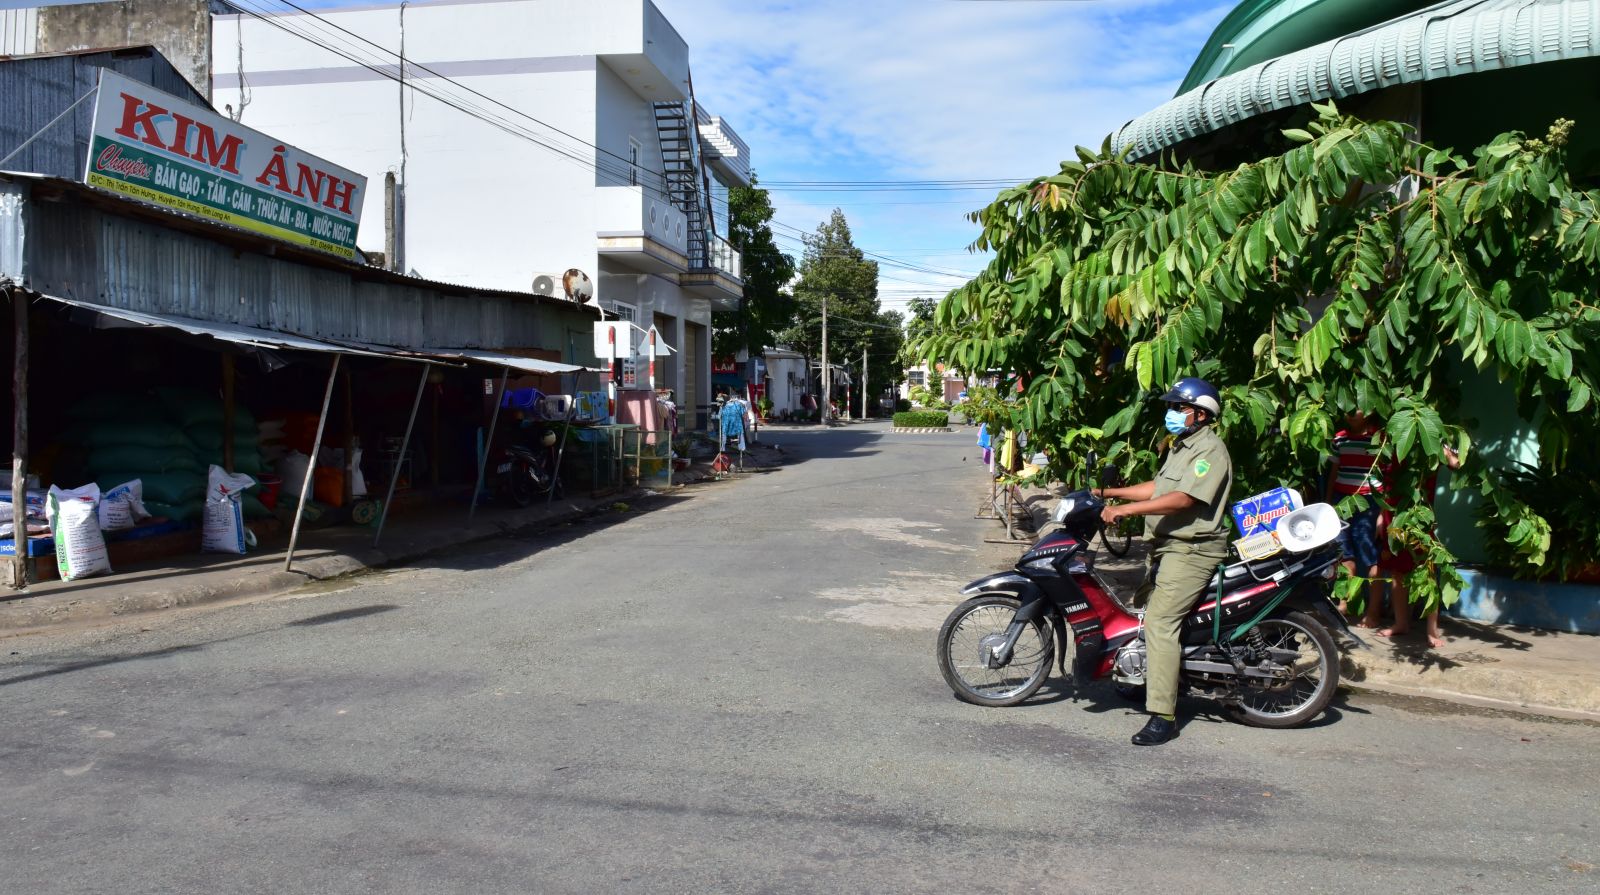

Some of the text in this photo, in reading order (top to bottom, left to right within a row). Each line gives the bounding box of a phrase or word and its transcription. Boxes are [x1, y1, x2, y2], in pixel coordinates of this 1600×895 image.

[115, 92, 243, 175] KIM
[154, 161, 178, 190] BÁN
[179, 171, 200, 199] GẠO
[207, 177, 227, 205] TẤM
[231, 186, 252, 213] CÁM
[257, 197, 279, 221] THỨC
[294, 209, 307, 230] BIA
[212, 209, 224, 220] Long
[224, 213, 231, 221] An
[1065, 602, 1089, 614] YAMAHA
